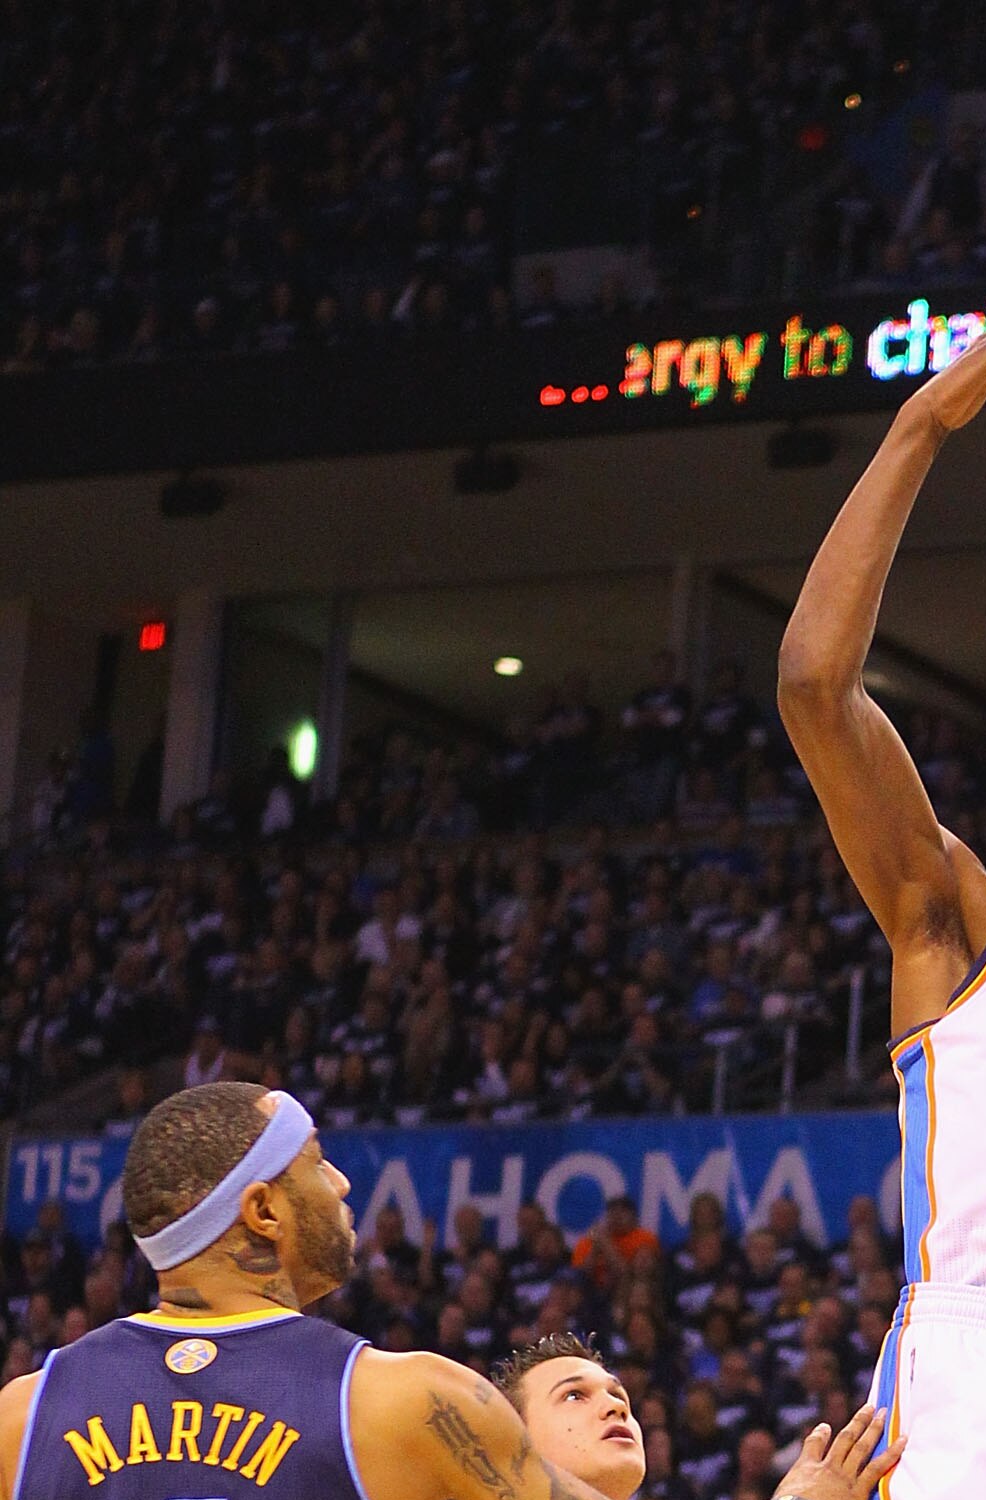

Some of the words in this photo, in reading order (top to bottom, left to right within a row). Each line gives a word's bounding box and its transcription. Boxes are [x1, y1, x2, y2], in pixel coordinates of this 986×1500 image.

[780, 313, 854, 381] to
[16, 1143, 101, 1202] 115
[63, 1399, 301, 1487] MARTIN
